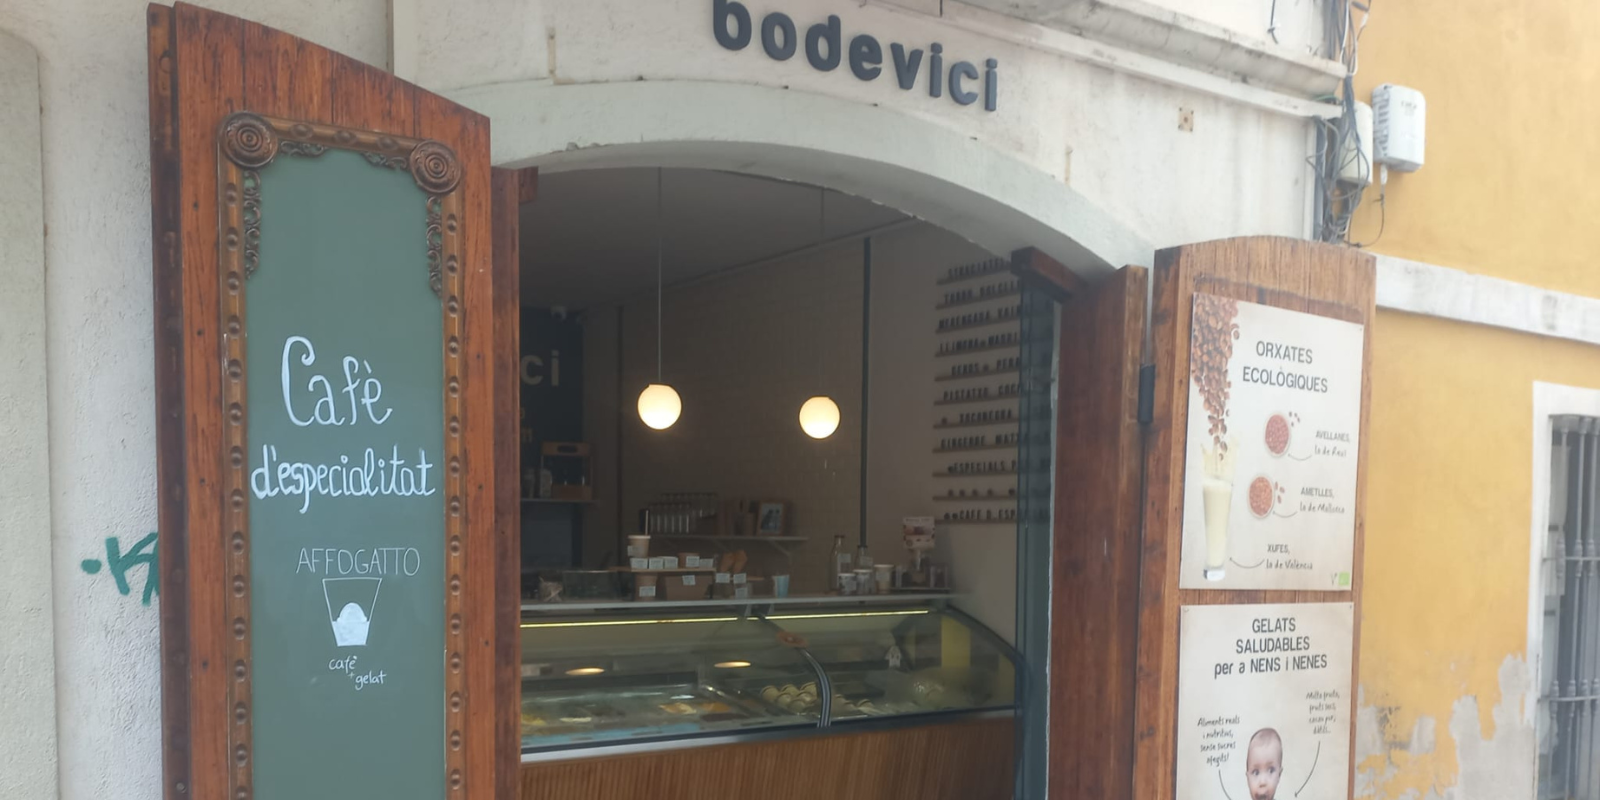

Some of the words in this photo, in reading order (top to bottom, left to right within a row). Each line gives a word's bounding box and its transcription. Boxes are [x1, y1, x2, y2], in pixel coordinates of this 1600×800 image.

[713, 0, 998, 112] bodevici
[1256, 341, 1313, 364] ORXATES
[281, 336, 393, 426] Cafè
[1242, 365, 1328, 393] ECOLÒGIQUES
[1322, 446, 1330, 455] de
[251, 442, 436, 514] d'especialitat
[1308, 503, 1316, 512] de
[296, 547, 421, 576] AFFOGATTO
[1274, 559, 1283, 569] de
[1252, 617, 1296, 633] GELATS
[1236, 636, 1310, 654] SALUDABLES
[1214, 661, 1233, 680] per
[1238, 662, 1245, 674] a
[1250, 656, 1281, 673] NENS
[1285, 656, 1289, 671] i
[1292, 654, 1328, 670] NENES
[355, 670, 388, 691] gelat
